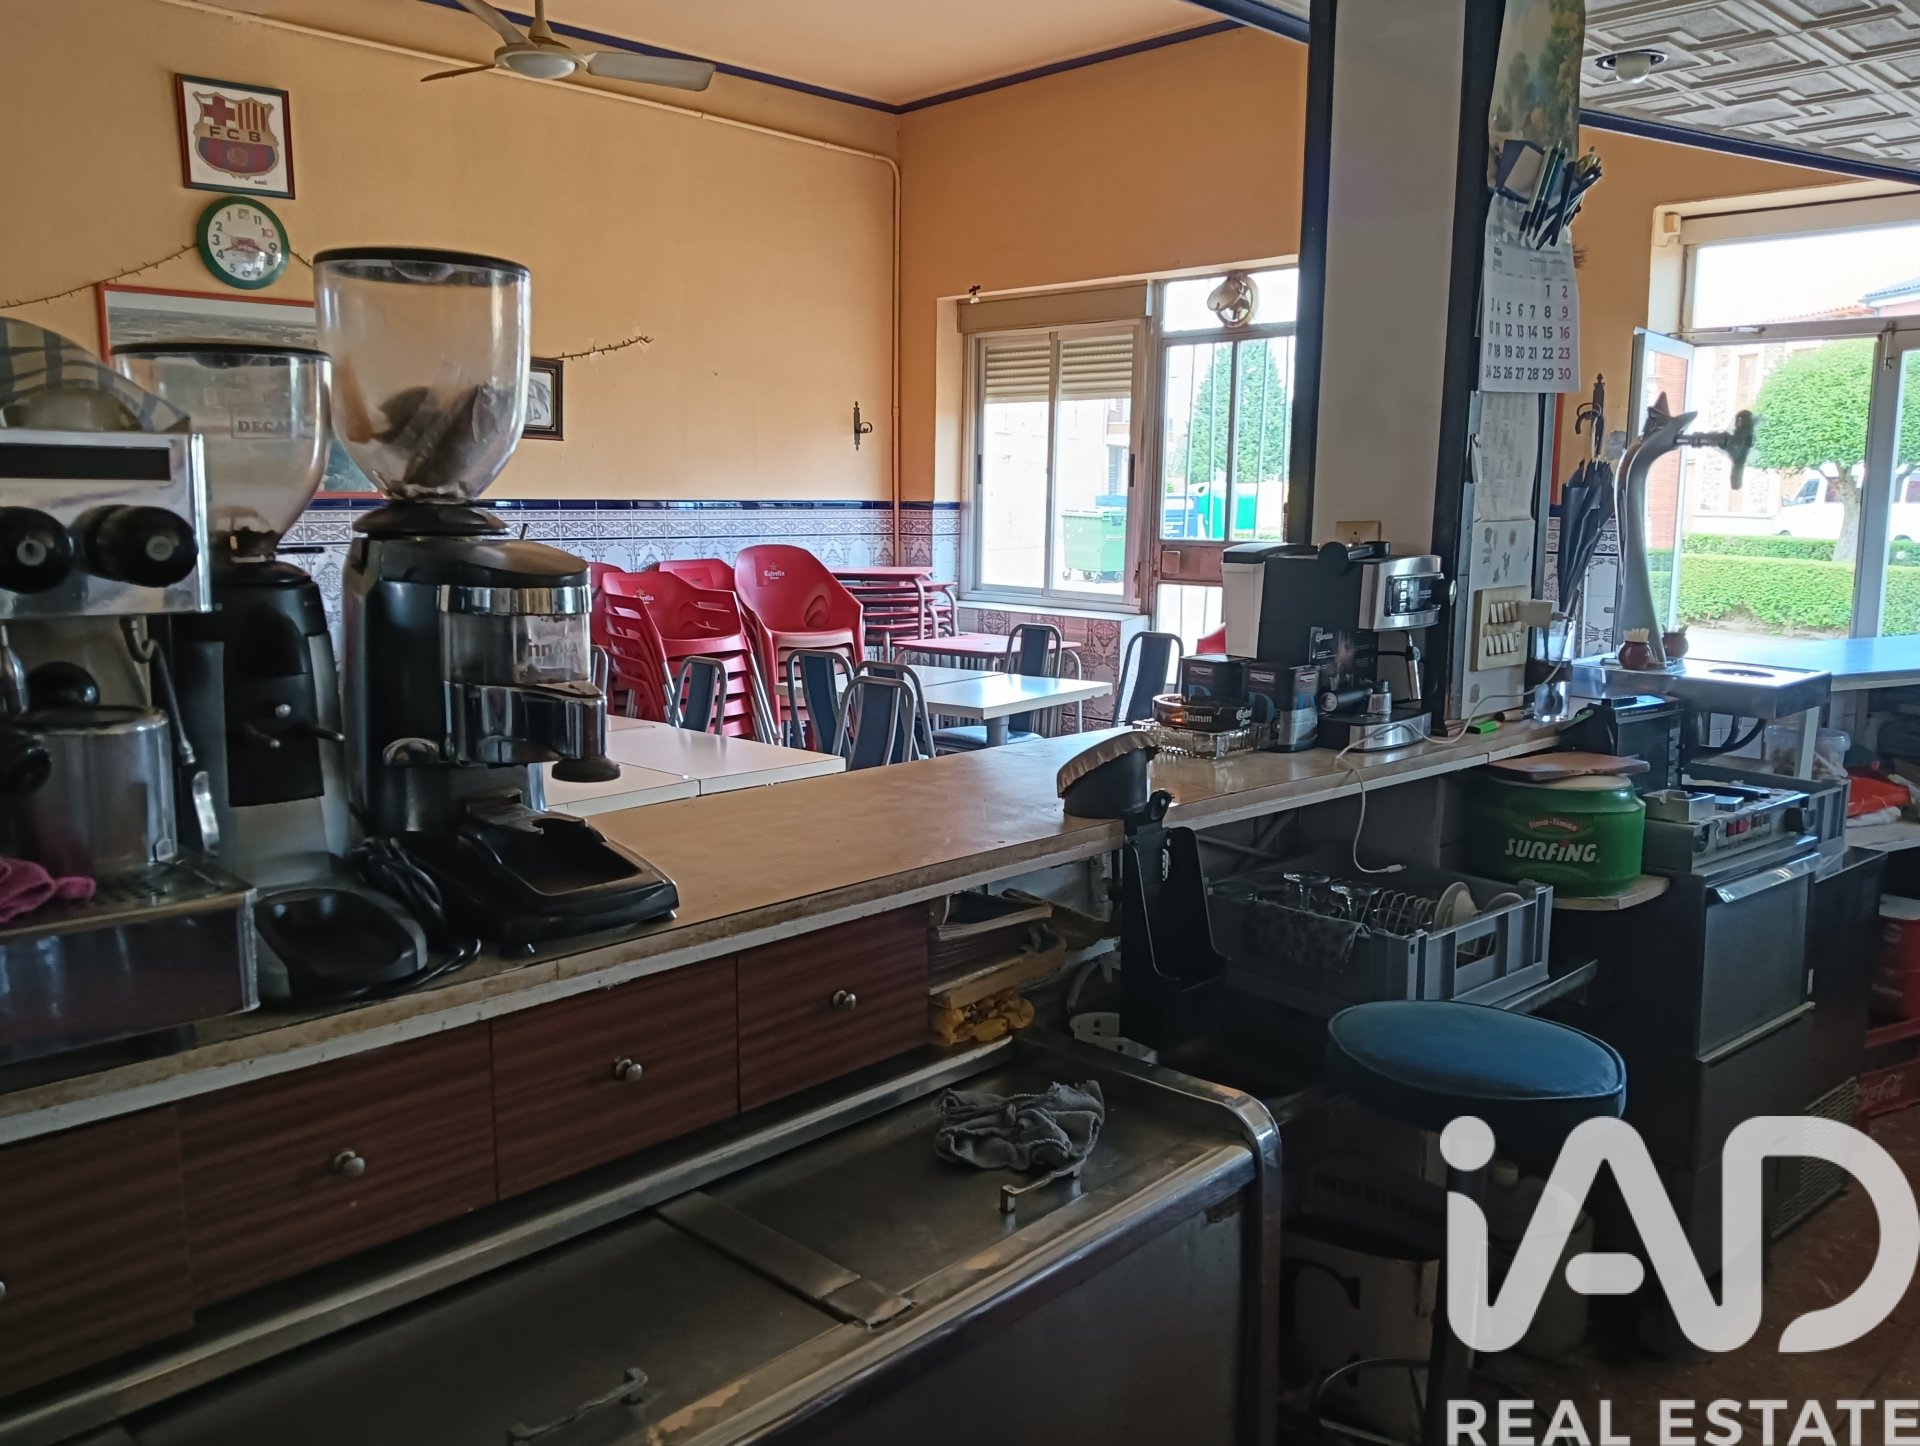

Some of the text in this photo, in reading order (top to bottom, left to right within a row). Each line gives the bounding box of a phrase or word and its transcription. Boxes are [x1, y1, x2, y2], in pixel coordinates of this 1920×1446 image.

[253, 215, 262, 225] 11
[215, 221, 223, 232] 2
[261, 228, 274, 238] 10
[211, 234, 220, 246] 3
[268, 242, 277, 253] 9
[216, 250, 224, 259] 4
[229, 263, 236, 273] 5
[1545, 284, 1568, 298] 1 2
[1506, 302, 1511, 314] 5
[1518, 304, 1524, 316] 6
[1529, 305, 1536, 317] 7
[1544, 306, 1551, 318] 8
[1562, 307, 1569, 318] 9
[1504, 323, 1512, 337] 12
[1516, 325, 1524, 337] 13
[1528, 325, 1537, 338] 14
[1542, 327, 1553, 339] 15
[1560, 327, 1570, 339] 16
[1494, 344, 1501, 357] 18
[1504, 345, 1512, 358] 19
[1515, 346, 1525, 359] 20
[1528, 347, 1537, 359] 21
[1542, 347, 1554, 359] 22
[1558, 347, 1571, 360] 23
[1493, 365, 1501, 379] 25
[1503, 366, 1513, 379] 26
[1515, 367, 1525, 380] 27
[1527, 367, 1539, 380] 28
[1542, 367, 1554, 380] 29
[1558, 367, 1571, 380] 30
